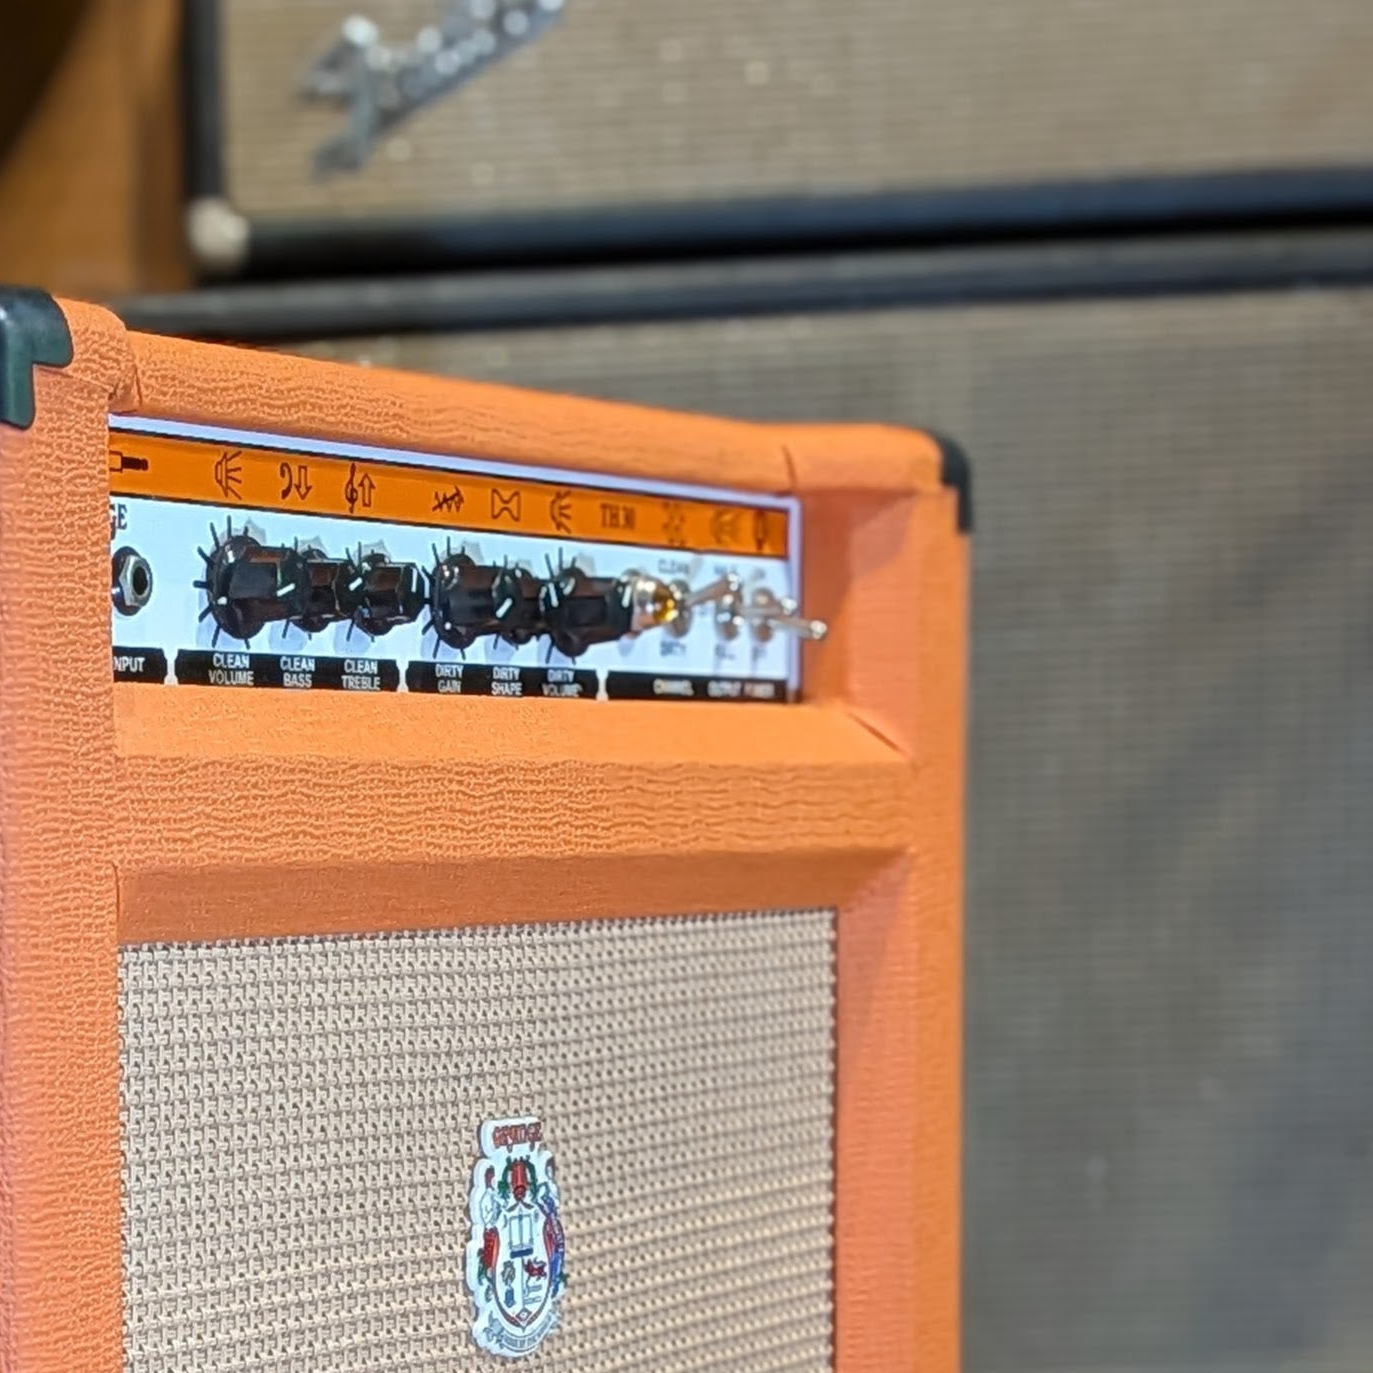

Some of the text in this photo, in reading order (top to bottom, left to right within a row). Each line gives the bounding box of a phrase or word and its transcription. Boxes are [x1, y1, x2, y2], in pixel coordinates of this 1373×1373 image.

[113, 656, 146, 672] NPUT
[212, 653, 250, 669] CLEAN
[280, 656, 315, 672] CLEAN
[344, 659, 378, 675] CLEAN
[208, 670, 254, 686] VOLUME
[435, 664, 464, 678] DIRTY
[492, 666, 520, 681] DIRTY
[283, 673, 312, 688] BASS
[341, 675, 381, 690] TREBLE
[437, 679, 462, 693] GAIN
[491, 682, 523, 696] SHAPE
